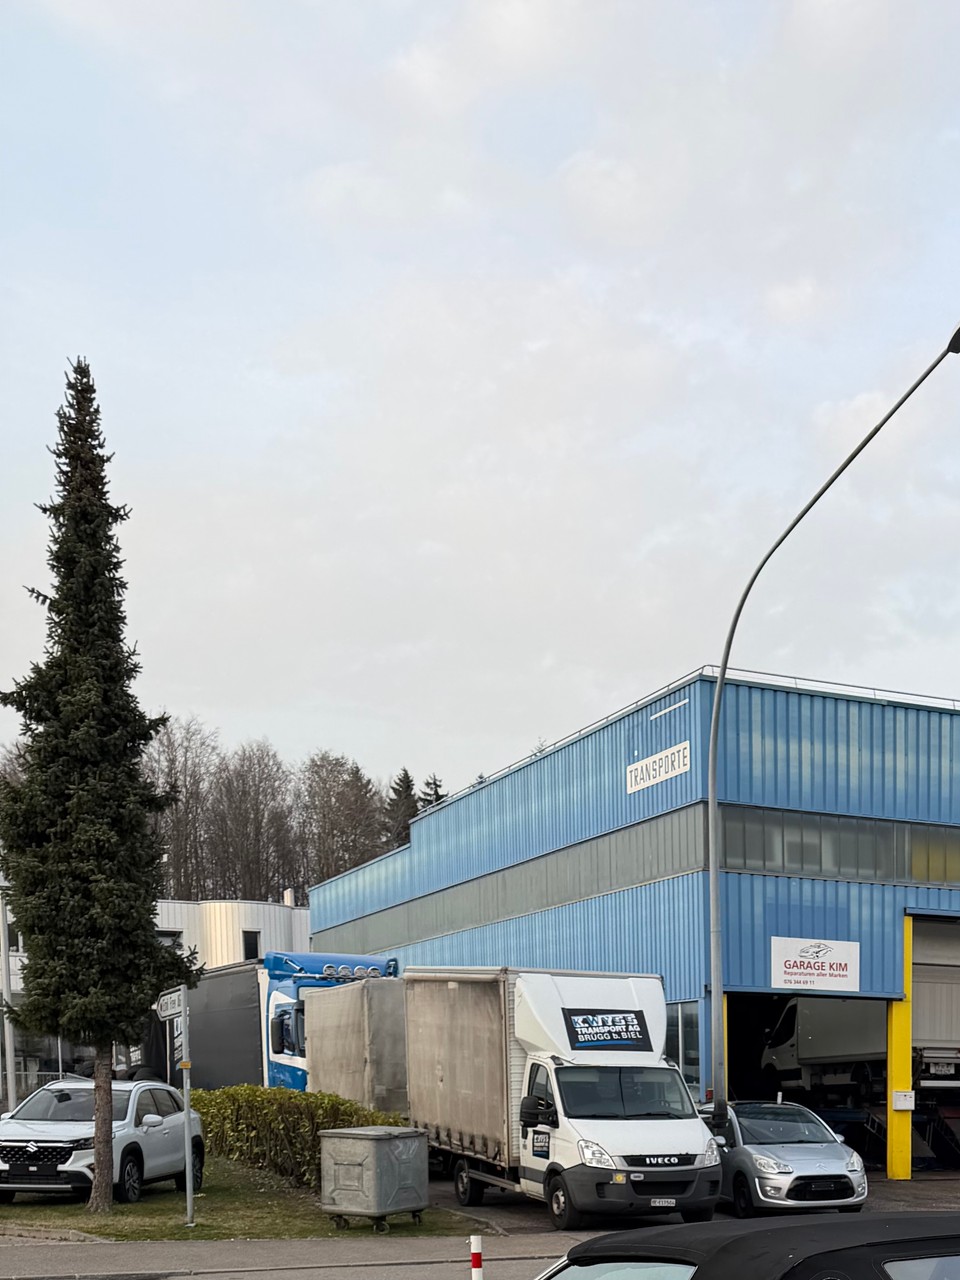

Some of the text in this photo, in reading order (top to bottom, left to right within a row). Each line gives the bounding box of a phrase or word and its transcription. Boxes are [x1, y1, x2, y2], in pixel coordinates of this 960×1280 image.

[629, 746, 688, 788] TRANSPORTE
[784, 960, 848, 972] GARAGE KIM
[575, 1025, 627, 1035] TRANSPORT
[621, 1031, 643, 1039] BIEL
